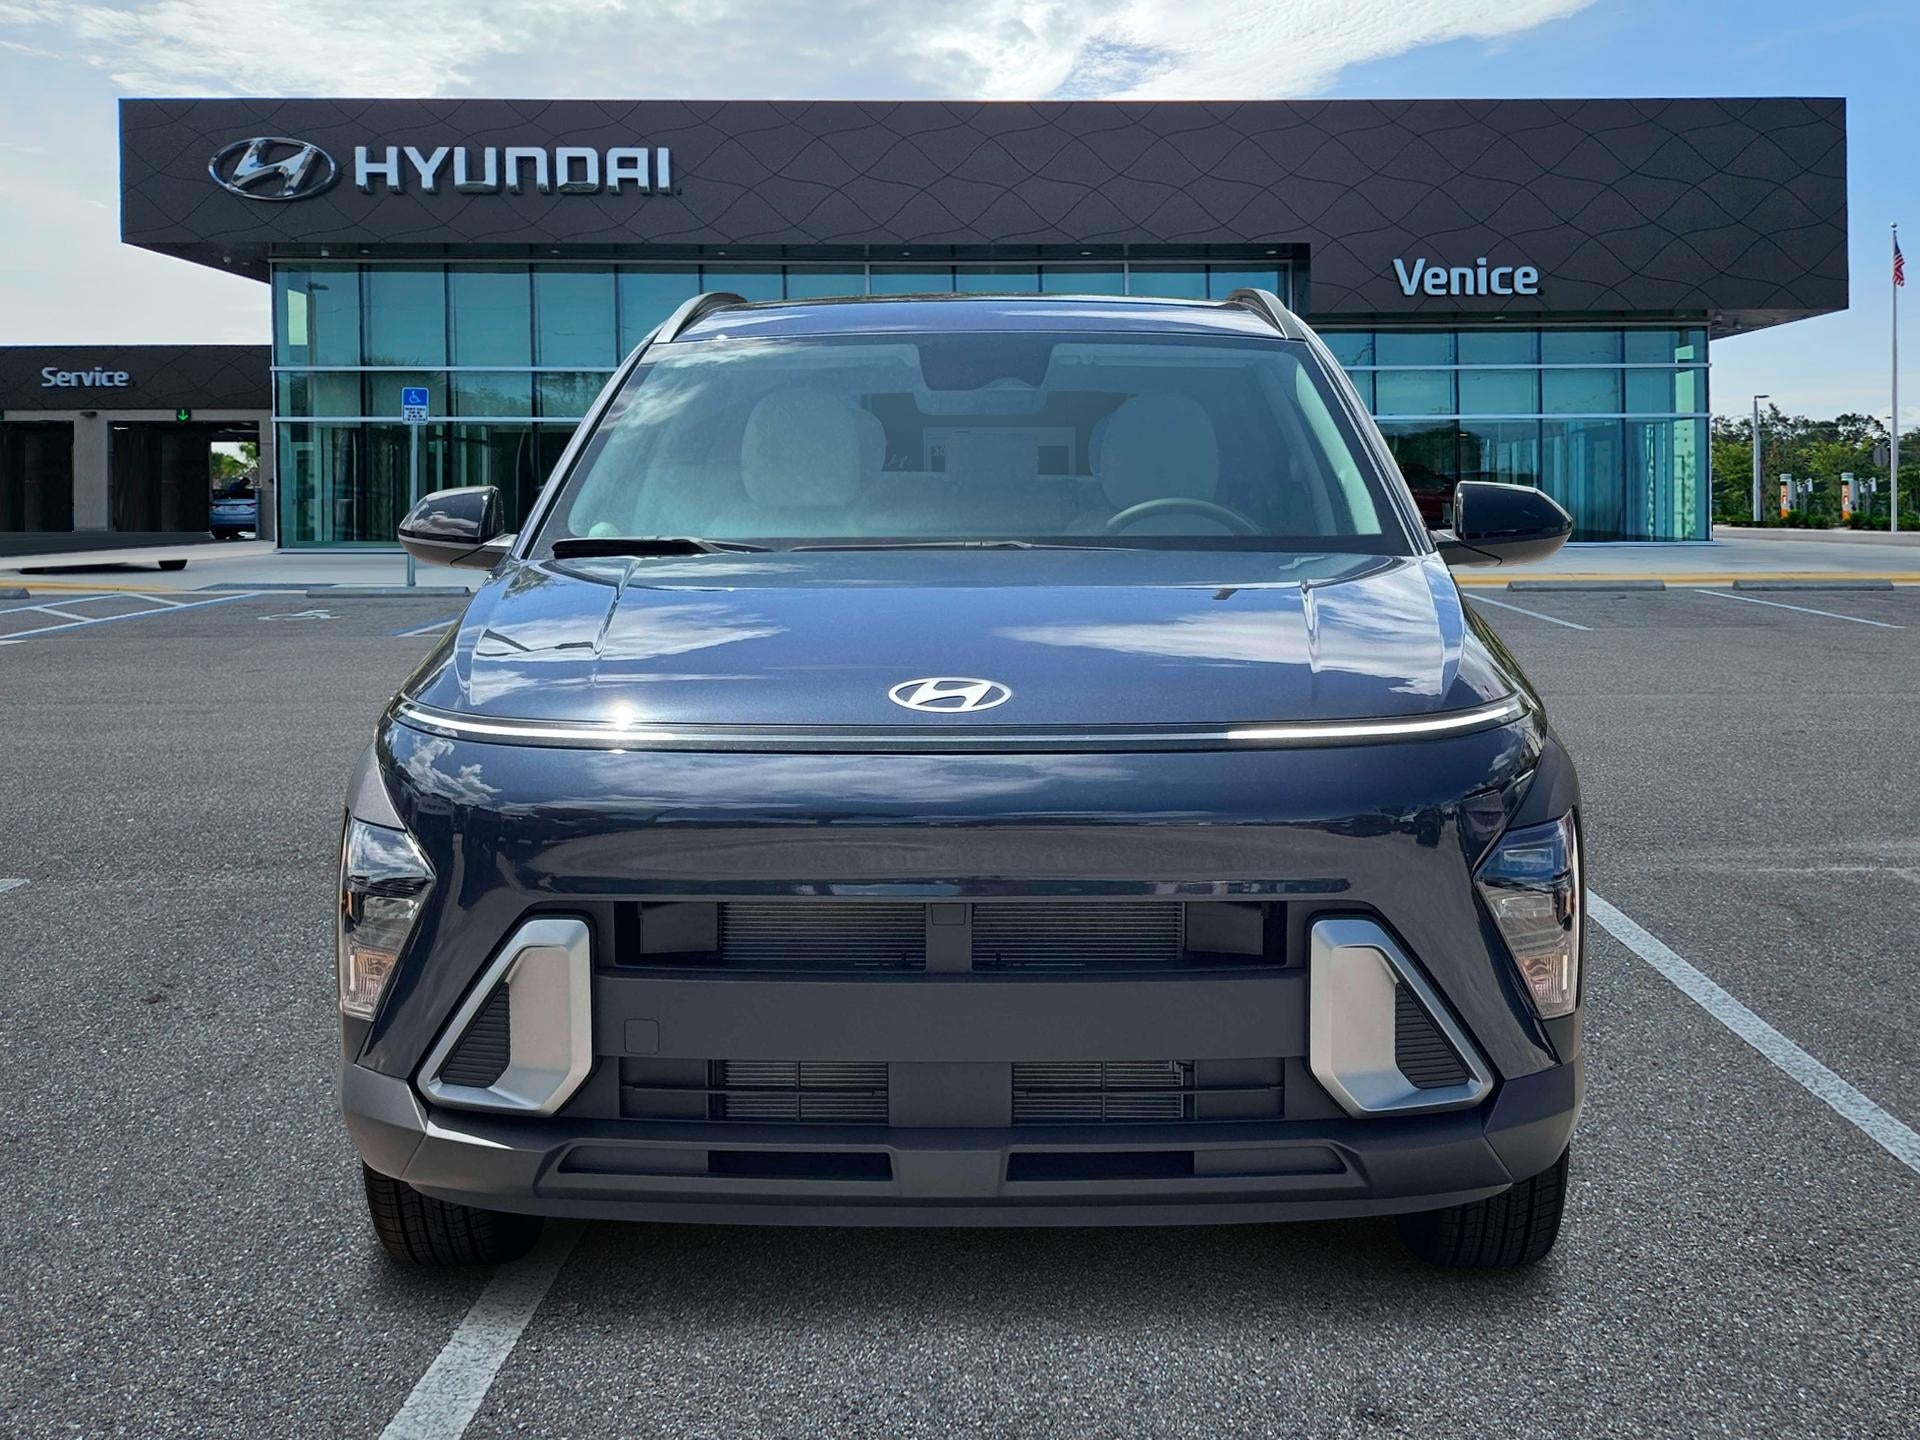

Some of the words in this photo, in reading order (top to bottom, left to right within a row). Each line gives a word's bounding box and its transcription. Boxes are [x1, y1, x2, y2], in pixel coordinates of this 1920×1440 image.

[353, 146, 671, 192] HYUNDAI
[1393, 257, 1539, 295] Venice
[41, 366, 129, 387] Service
